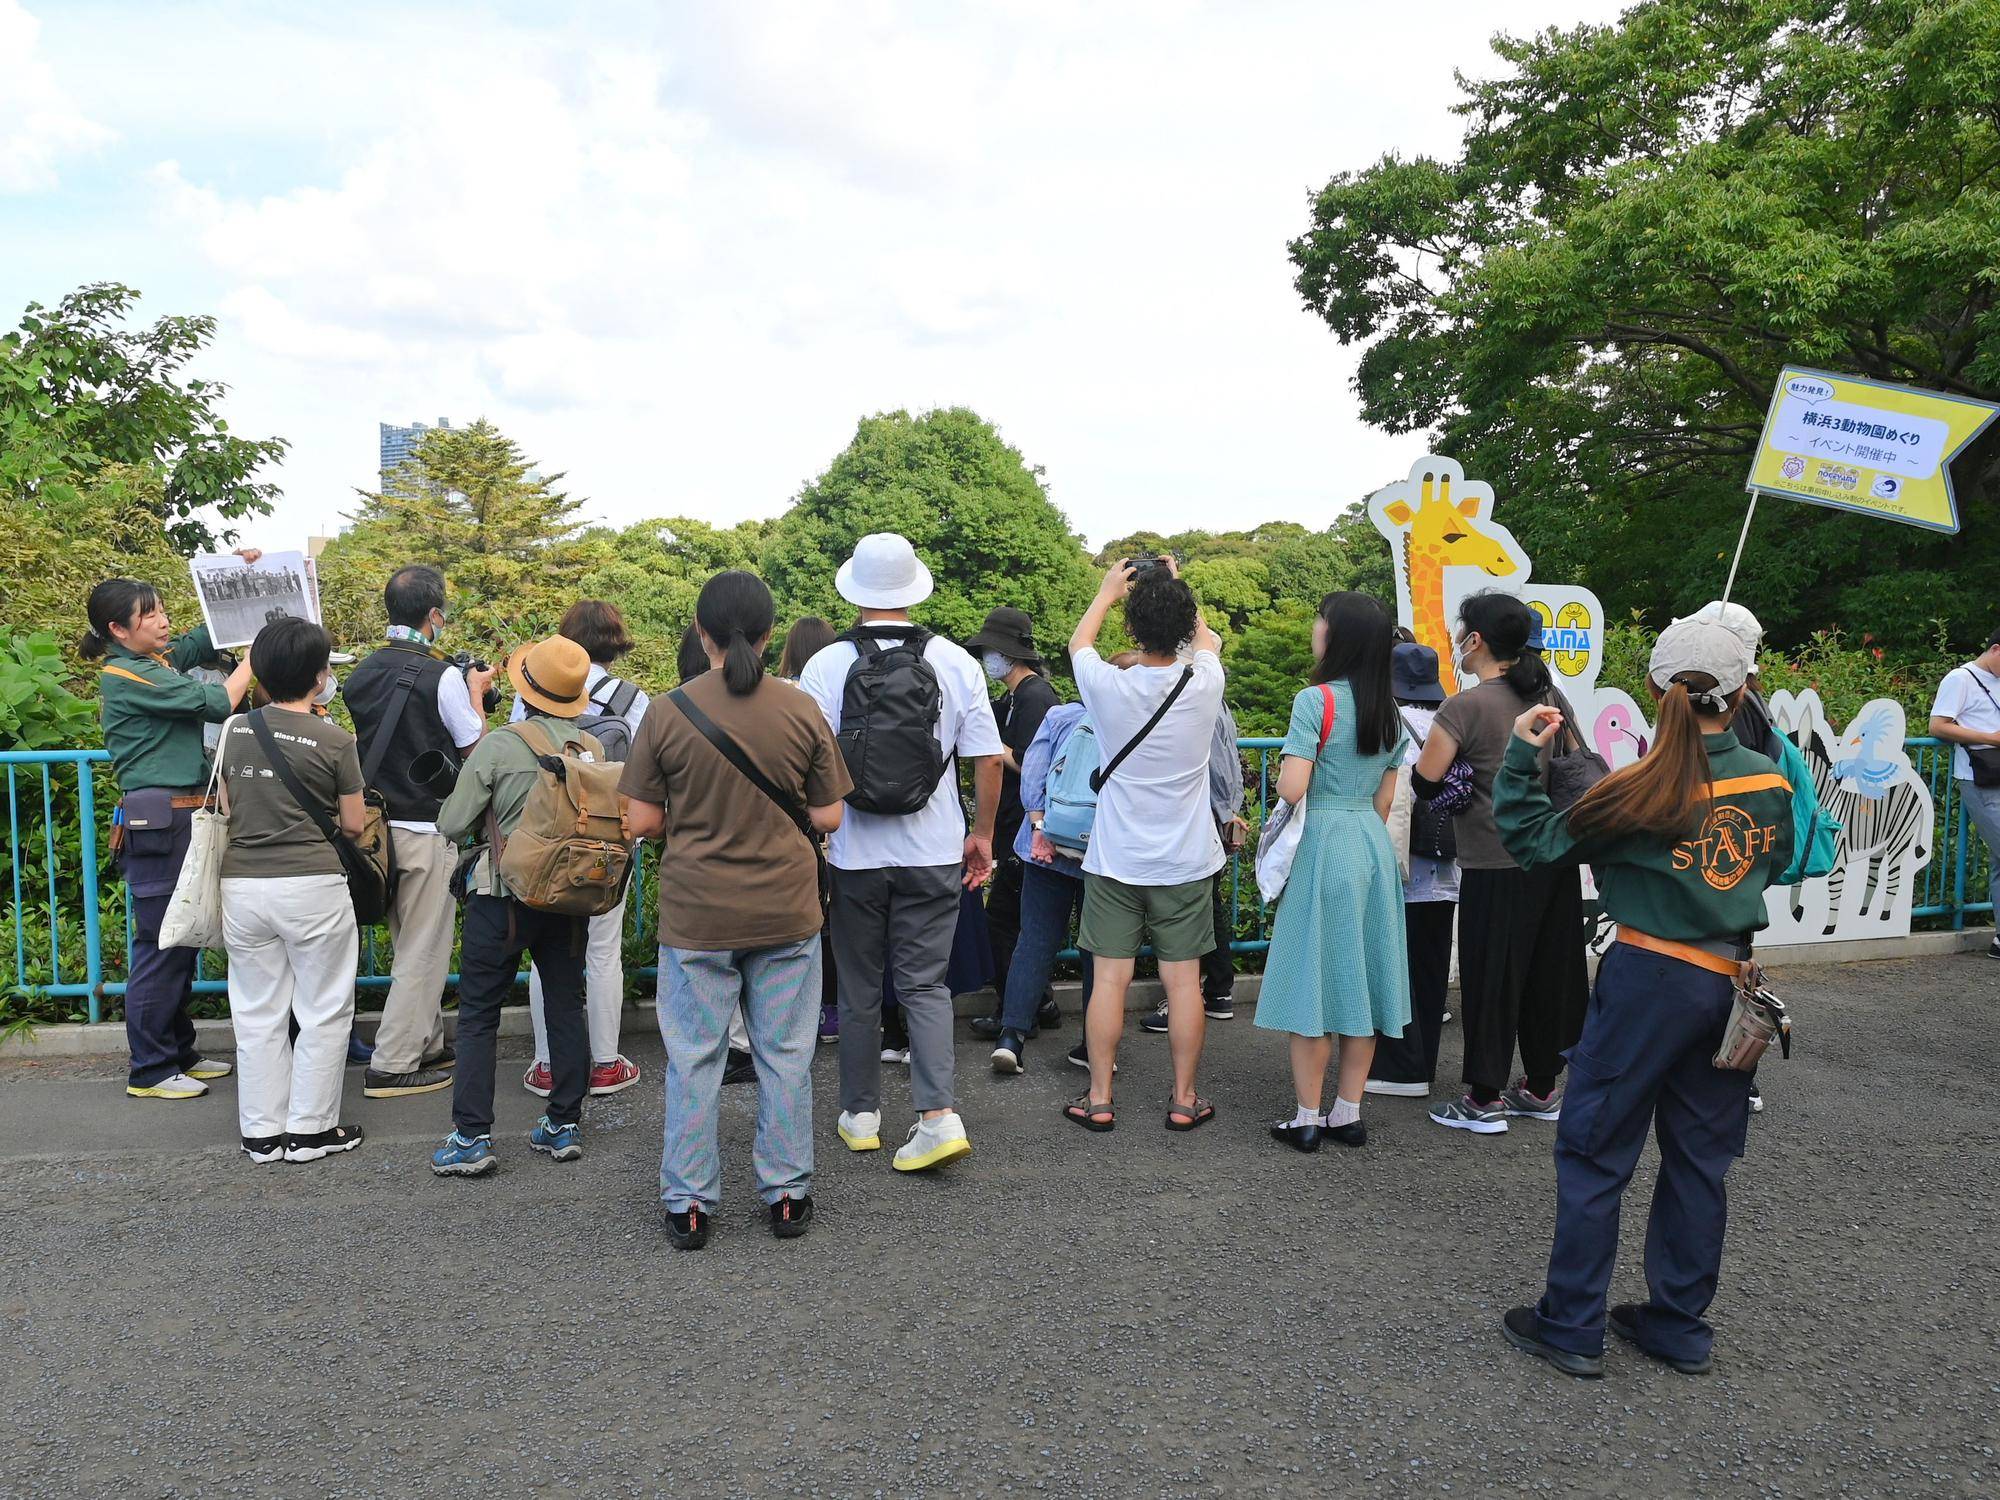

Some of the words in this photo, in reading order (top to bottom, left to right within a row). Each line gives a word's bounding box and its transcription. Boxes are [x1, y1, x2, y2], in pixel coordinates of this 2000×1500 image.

[1802, 411, 1921, 446] 横浜3動物園めぐり
[1672, 825, 1776, 870] STAFF
